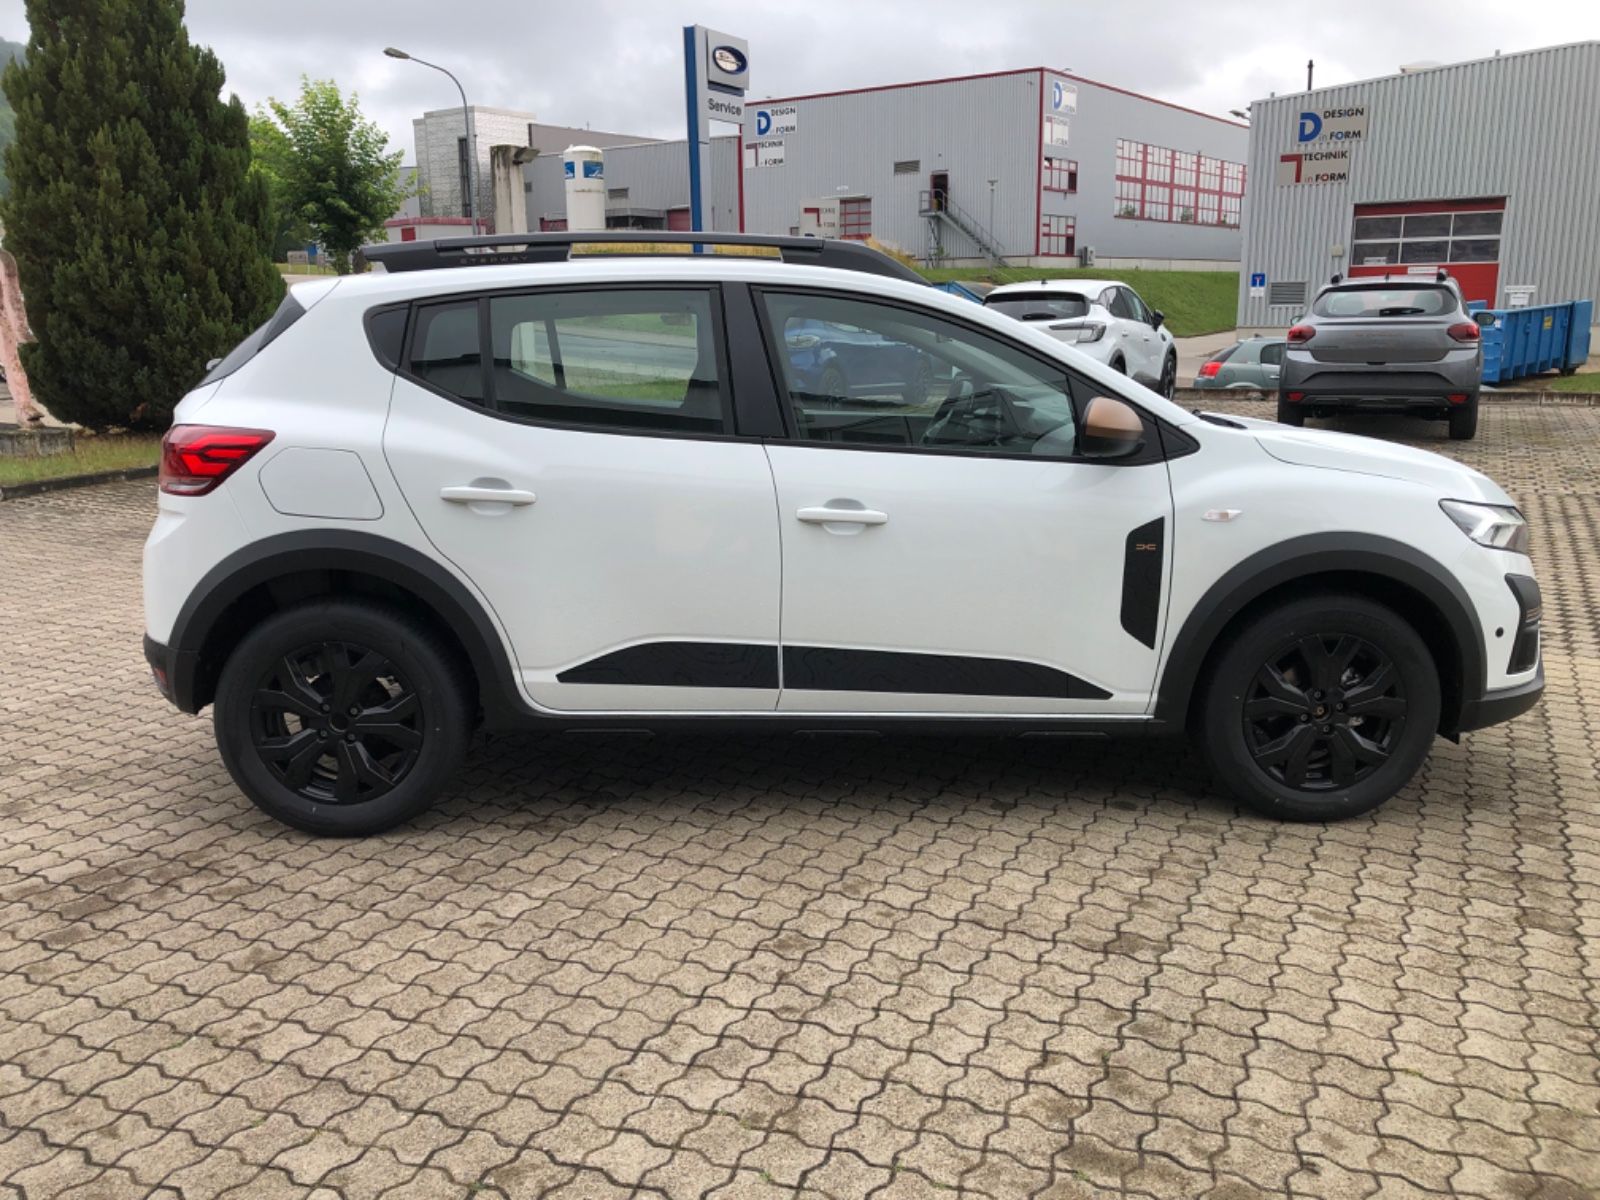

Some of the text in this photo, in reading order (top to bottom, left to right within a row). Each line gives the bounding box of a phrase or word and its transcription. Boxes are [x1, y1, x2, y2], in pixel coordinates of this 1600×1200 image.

[708, 98, 742, 116] Service
[1323, 108, 1364, 119] DESIGN
[1329, 130, 1361, 140] FORM
[1303, 151, 1348, 161] TECHNIK
[1315, 173, 1347, 182] FORM
